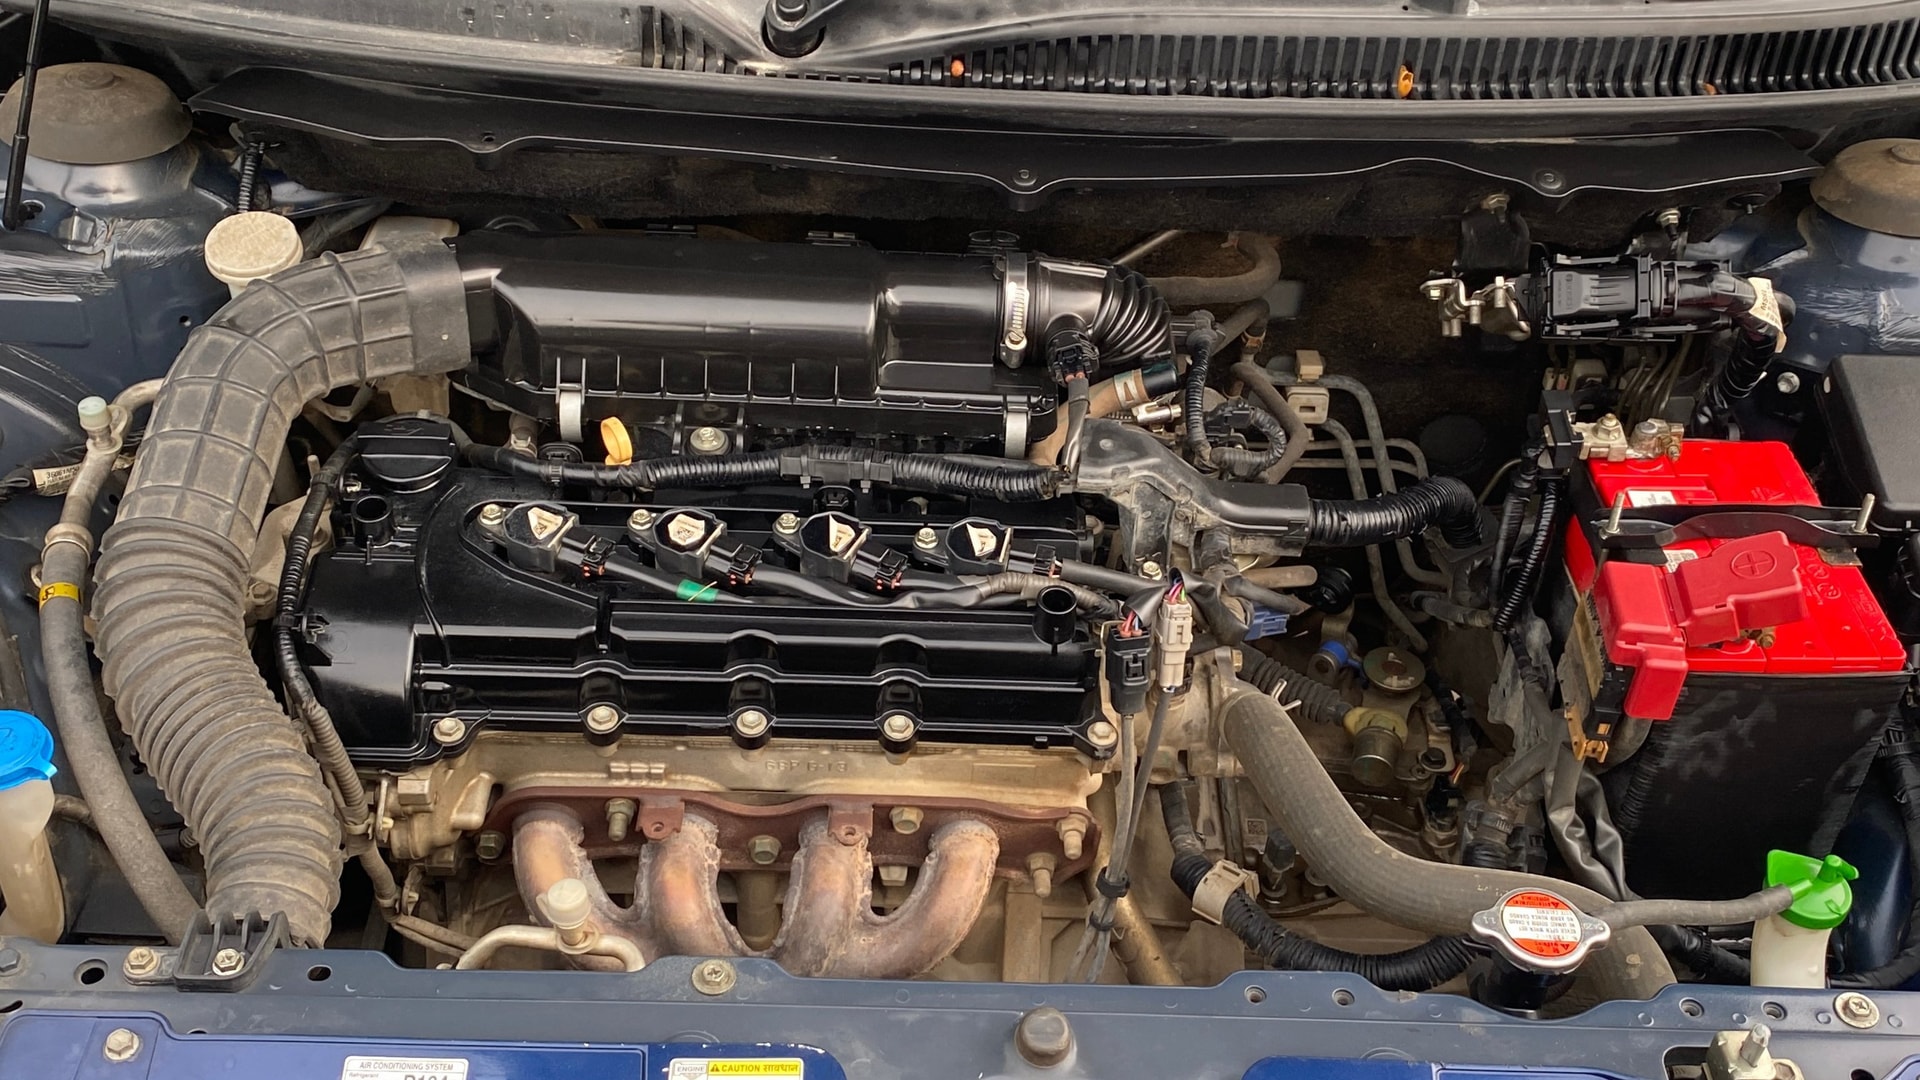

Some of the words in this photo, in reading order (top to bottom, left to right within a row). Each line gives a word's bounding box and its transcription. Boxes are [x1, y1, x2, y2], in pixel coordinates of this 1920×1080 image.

[360, 1061, 372, 1069] AIR
[373, 1061, 423, 1070] CONDITIONING
[425, 1063, 454, 1071] SYSTEM
[676, 1065, 705, 1073] ENGINE
[721, 1064, 760, 1073] CAUTION
[763, 1064, 799, 1073] सावधान
